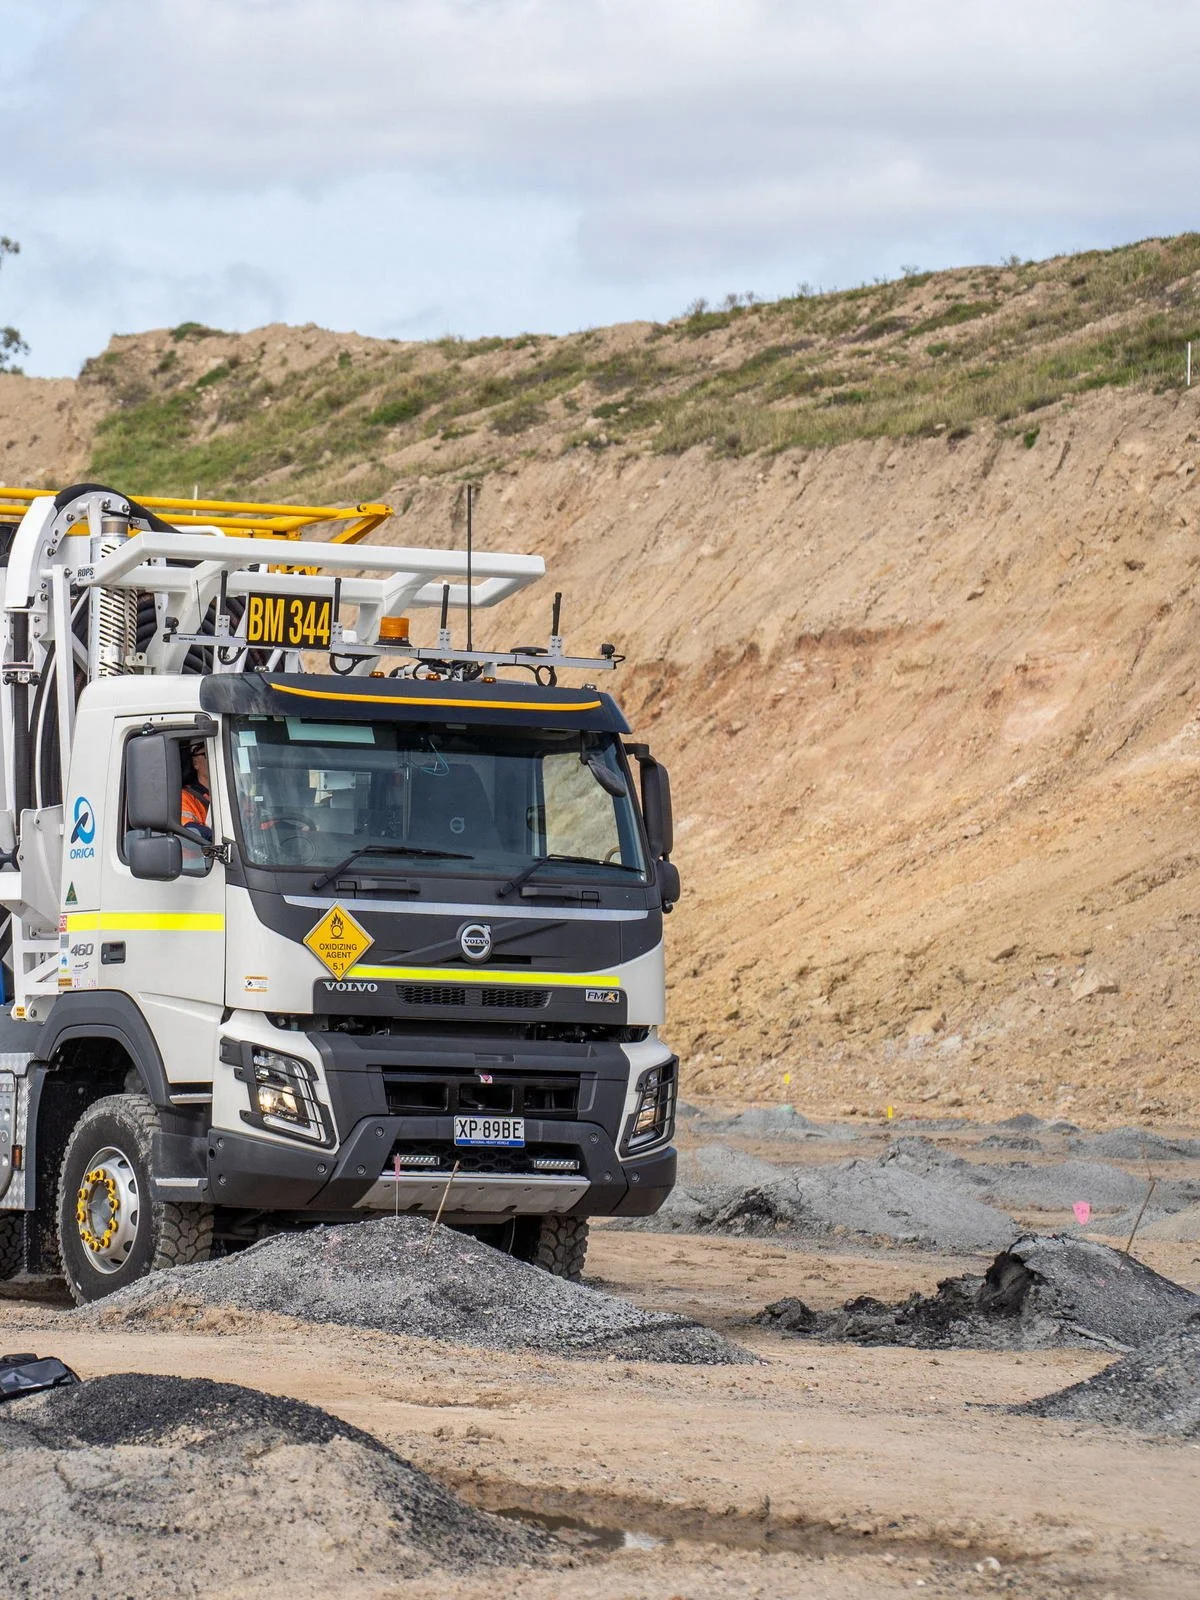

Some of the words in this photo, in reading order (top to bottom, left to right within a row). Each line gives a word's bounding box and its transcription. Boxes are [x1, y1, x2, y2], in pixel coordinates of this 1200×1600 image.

[77, 567, 94, 577] ROPS
[248, 597, 285, 643] BM
[289, 599, 330, 645] 344
[69, 847, 95, 860] ORICA
[70, 943, 94, 956] 460
[318, 943, 358, 951] OXIDIZING
[326, 951, 352, 959] AGENT
[332, 962, 344, 971] 5.1
[323, 981, 379, 993] VOLVO
[587, 991, 619, 1003] FMX
